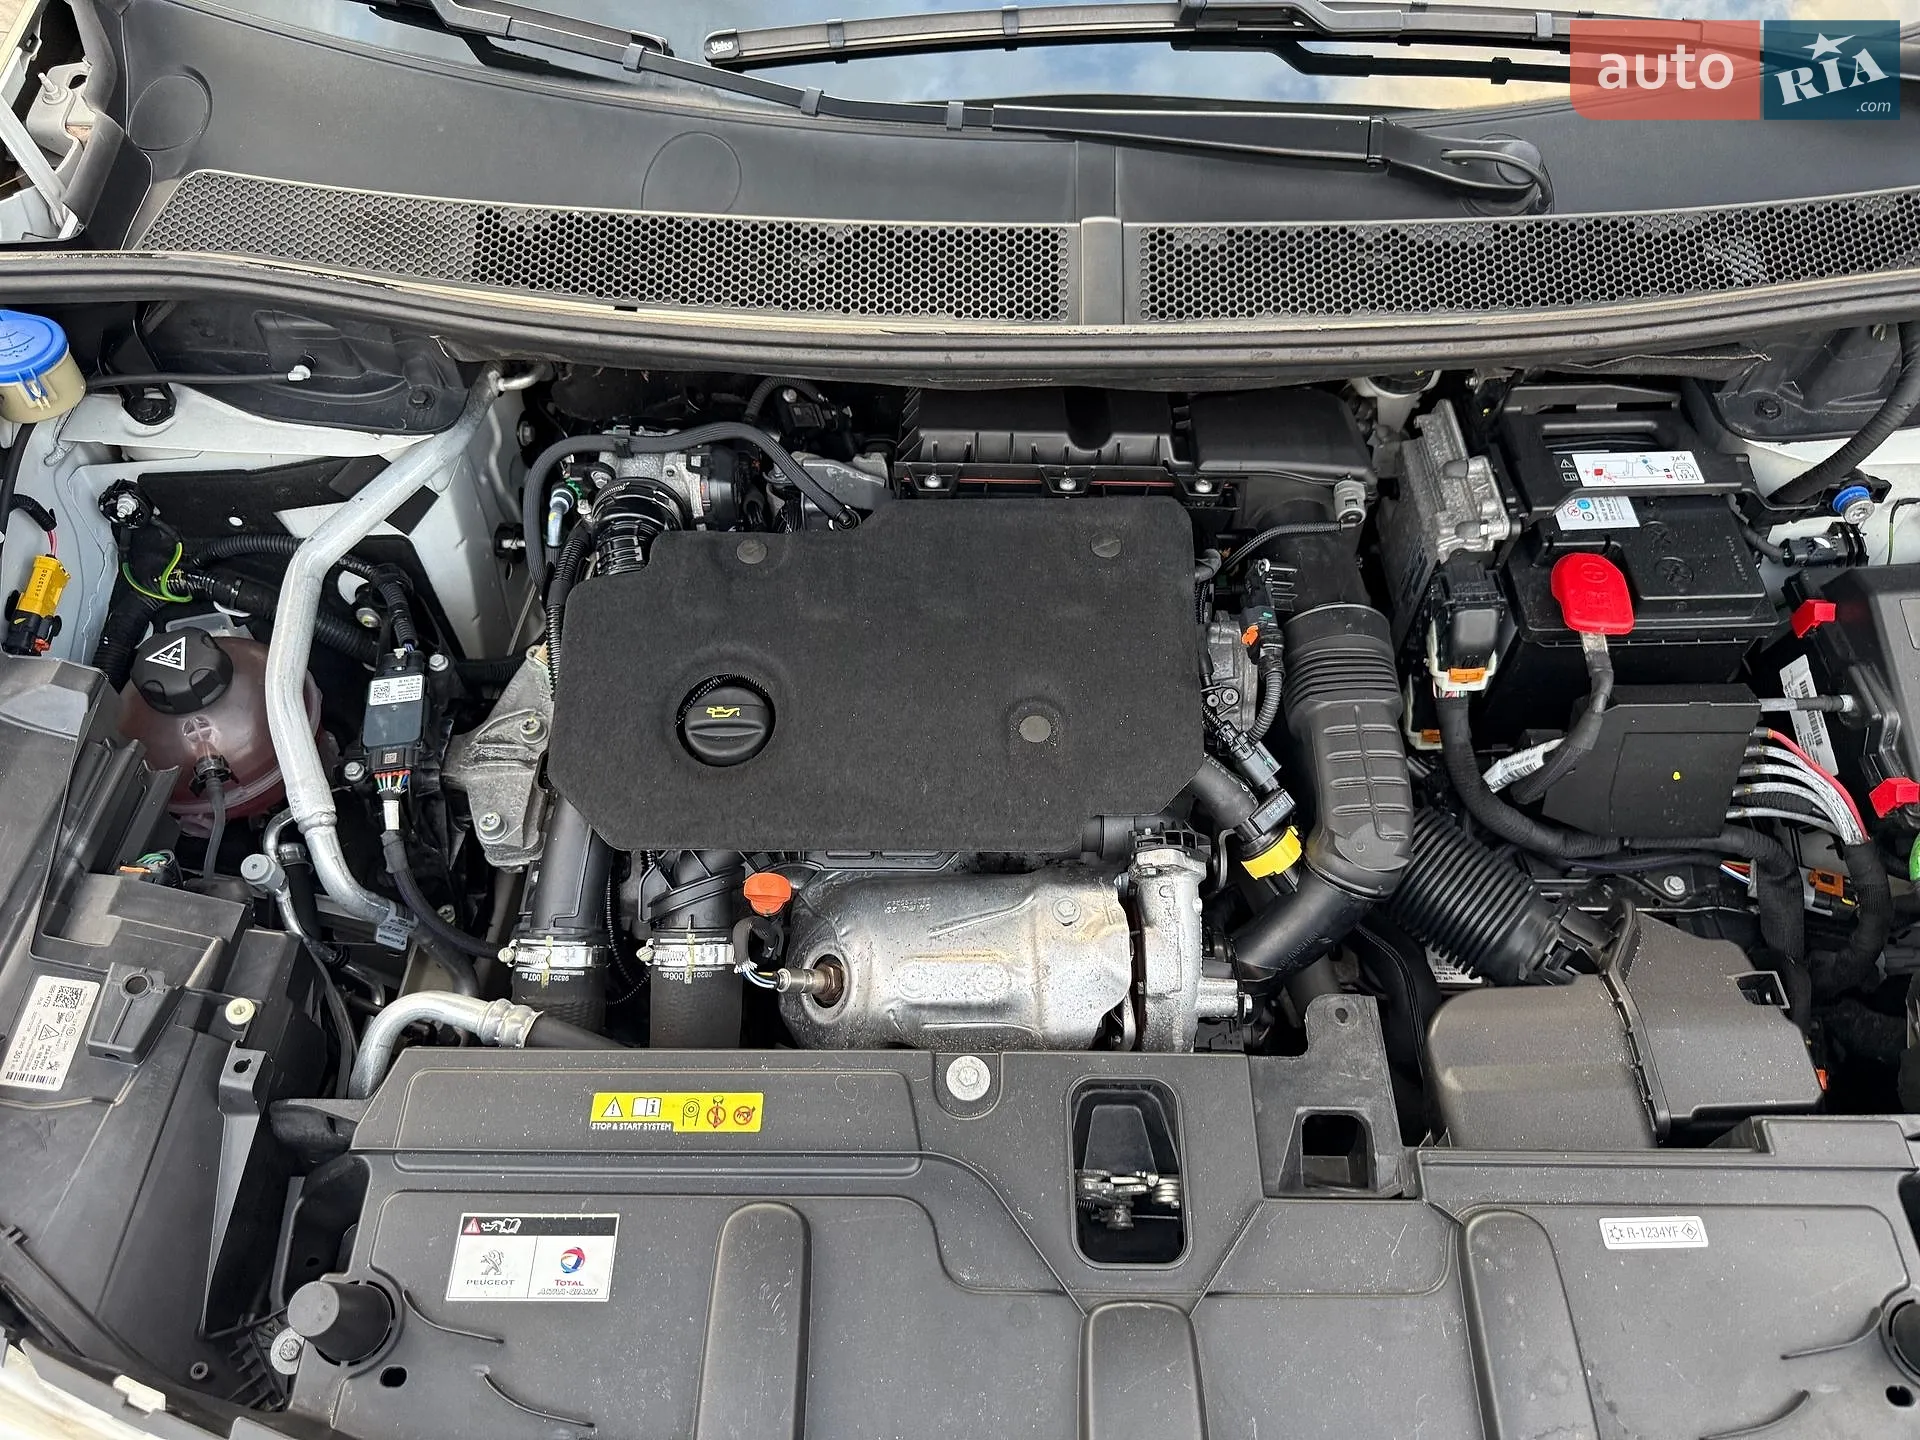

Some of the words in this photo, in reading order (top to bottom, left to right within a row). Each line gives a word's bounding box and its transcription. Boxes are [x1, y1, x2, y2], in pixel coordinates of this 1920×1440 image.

[591, 1122, 611, 1130] STOP
[612, 1122, 618, 1130] &
[619, 1122, 641, 1131] START
[643, 1123, 672, 1131] SYSTEM
[1626, 1225, 1679, 1239] R-1234YF
